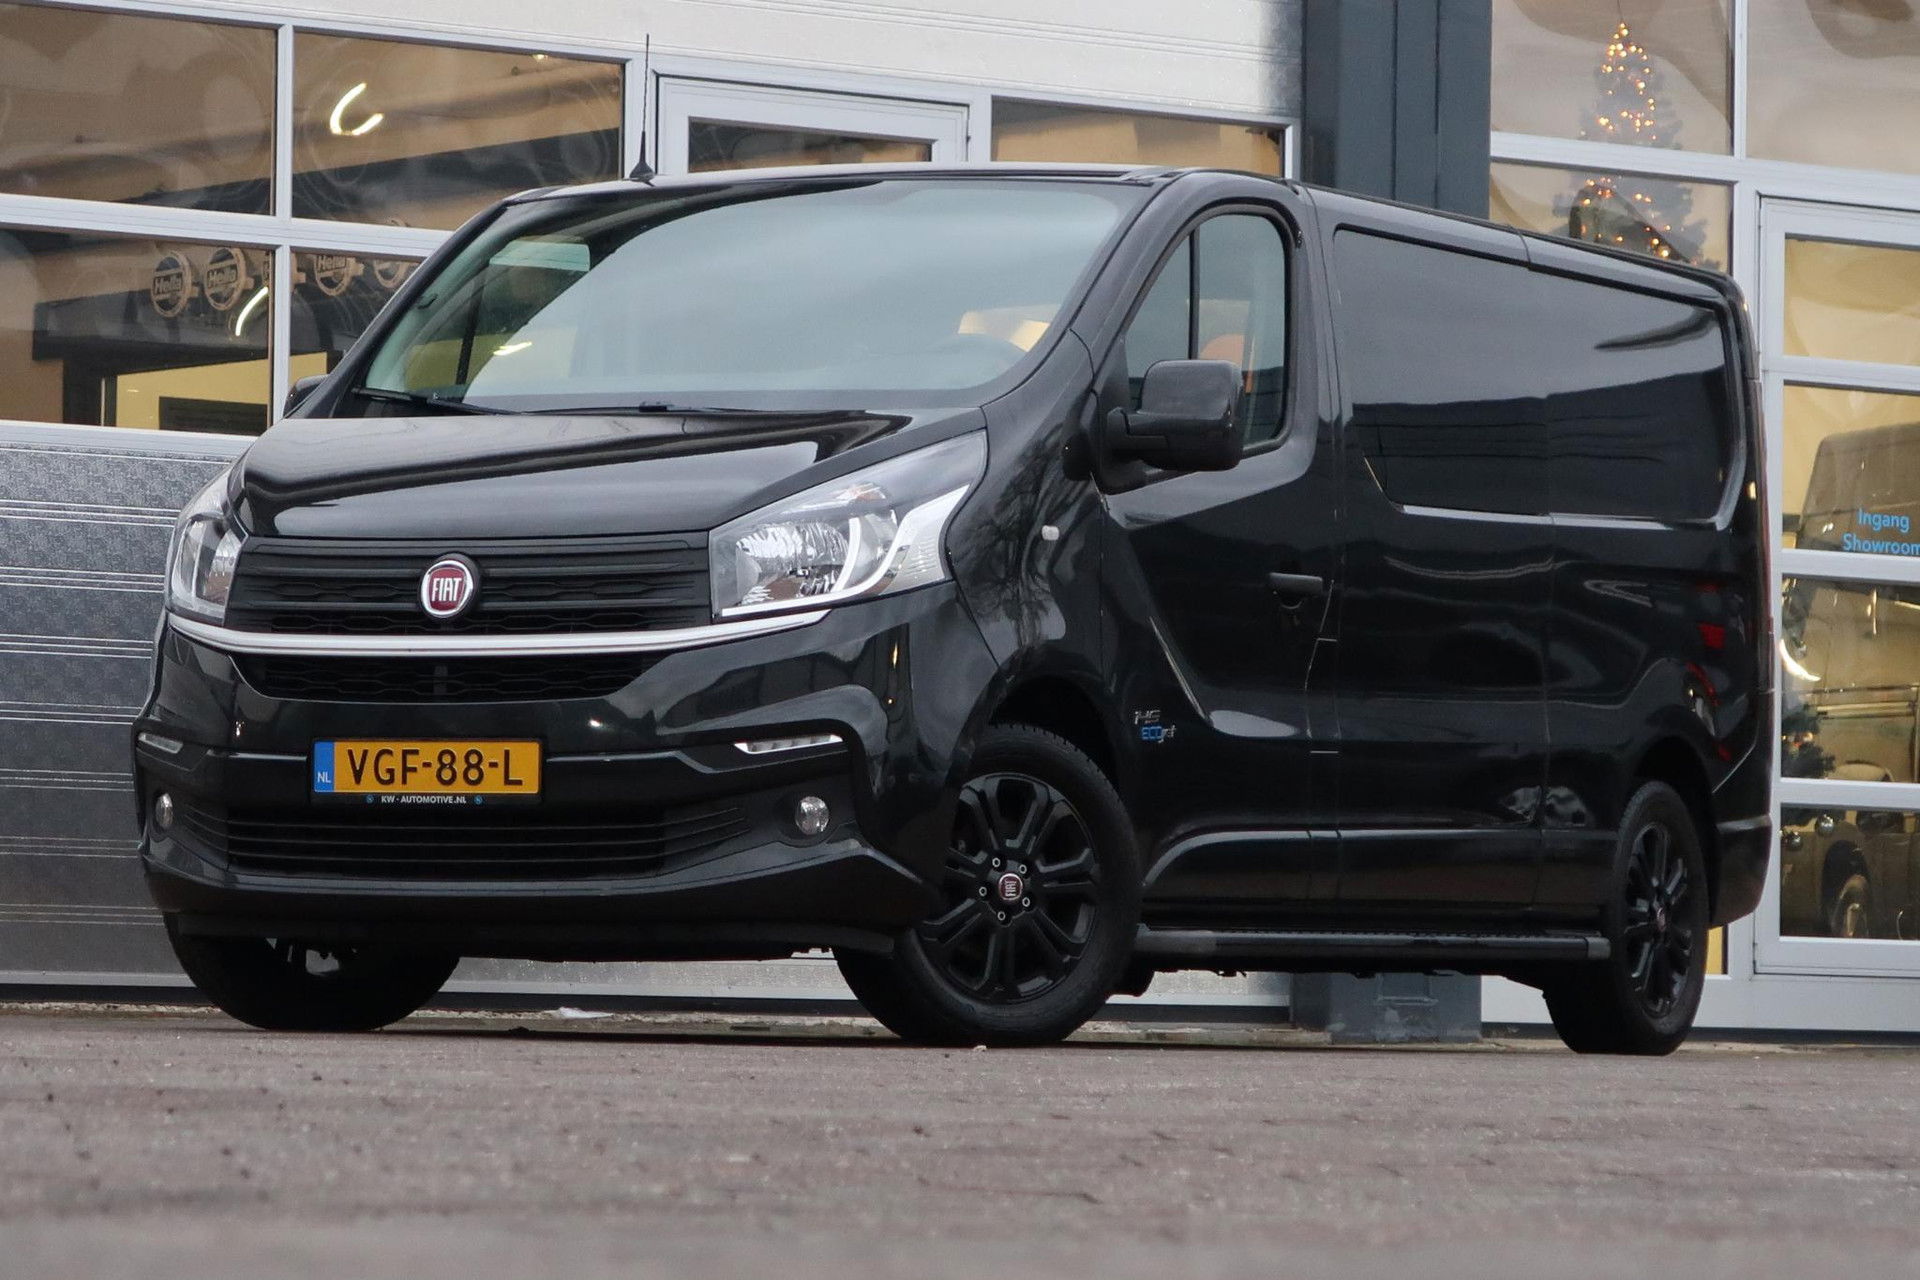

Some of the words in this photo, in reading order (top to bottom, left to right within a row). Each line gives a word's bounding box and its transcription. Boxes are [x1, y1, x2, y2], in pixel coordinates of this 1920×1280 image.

[1857, 508, 1910, 533] Ingang
[431, 577, 462, 602] FIAT
[317, 770, 331, 783] NL
[347, 748, 523, 786] VGF-88-L
